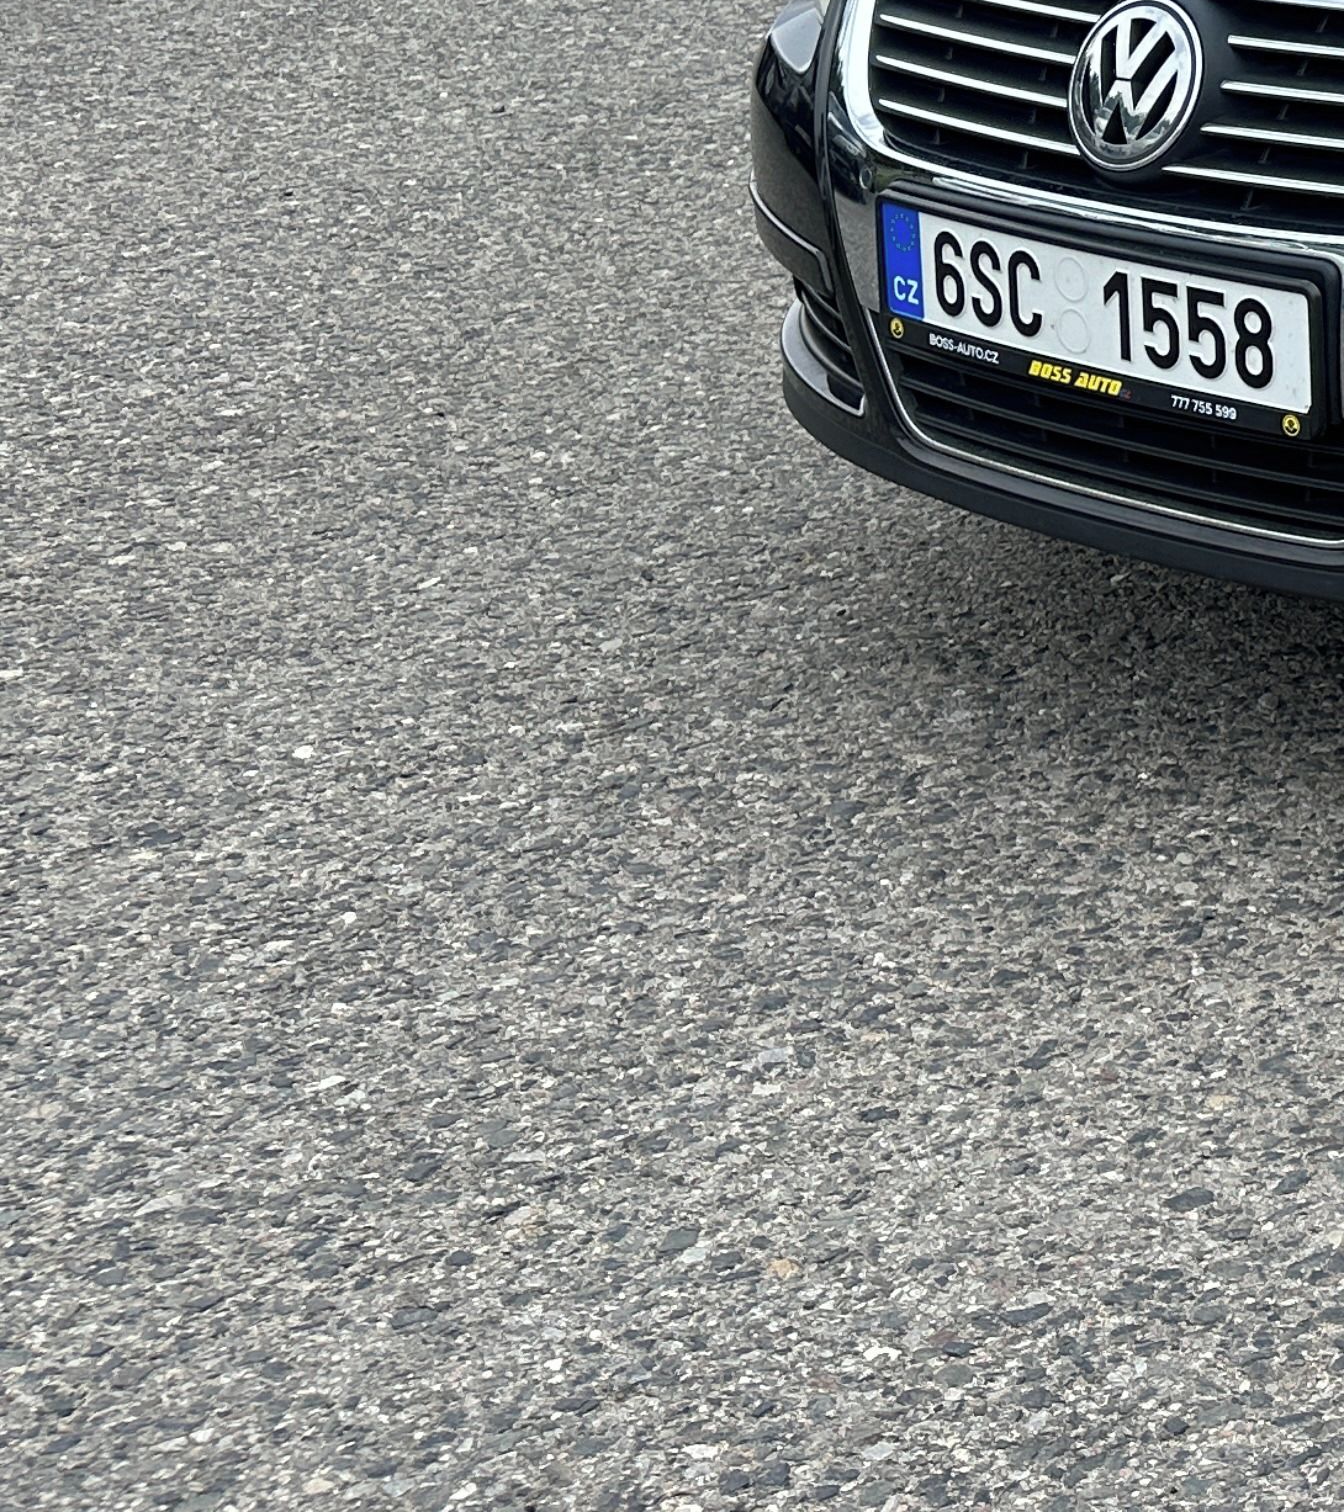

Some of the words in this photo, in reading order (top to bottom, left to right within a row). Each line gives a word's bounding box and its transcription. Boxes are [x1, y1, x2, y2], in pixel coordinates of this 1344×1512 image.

[893, 275, 920, 306] CZ
[932, 229, 1043, 338] 6SC
[1102, 270, 1276, 390] 1558
[929, 333, 1000, 365] BOSS-AUTO.CZ
[1028, 359, 1072, 384] BOSS
[1074, 371, 1123, 397] AUTO
[1170, 394, 1190, 411] 777
[1192, 399, 1214, 416] 755
[1215, 403, 1238, 421] 599
